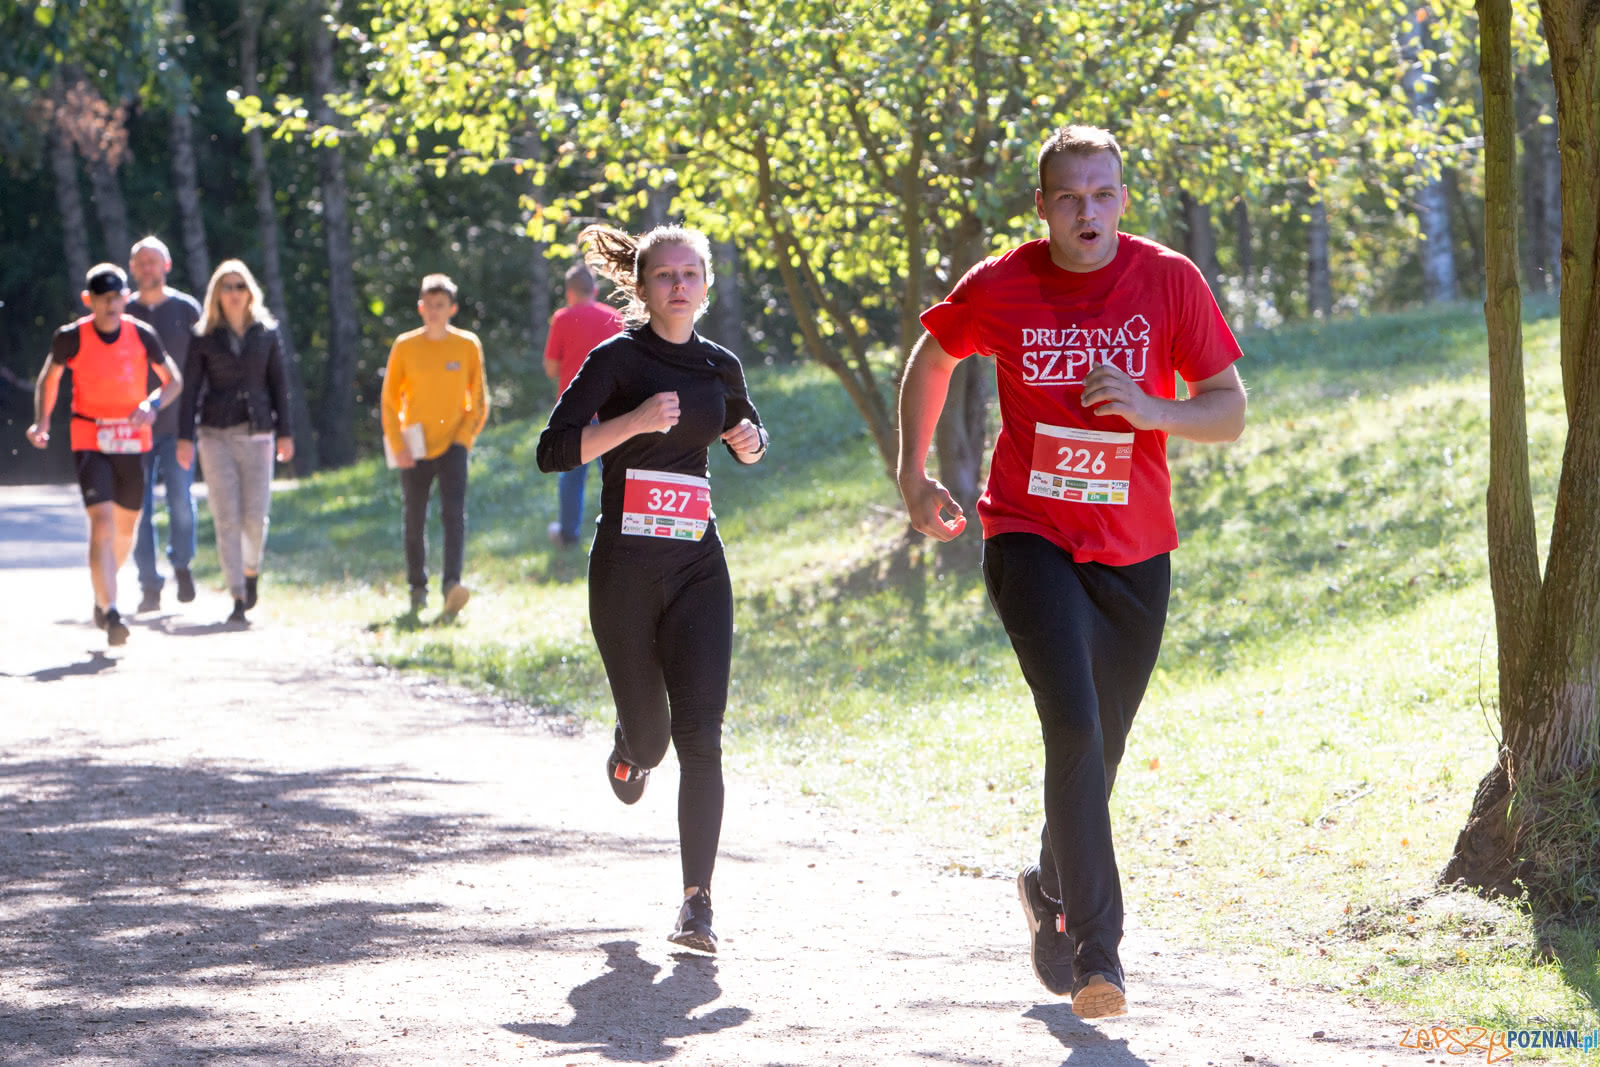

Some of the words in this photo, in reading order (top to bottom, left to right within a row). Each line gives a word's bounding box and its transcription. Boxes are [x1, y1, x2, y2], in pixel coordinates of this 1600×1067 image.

[1022, 323, 1128, 347] DRUŻYNA
[1056, 447, 1106, 475] 226
[648, 488, 691, 512] 327
